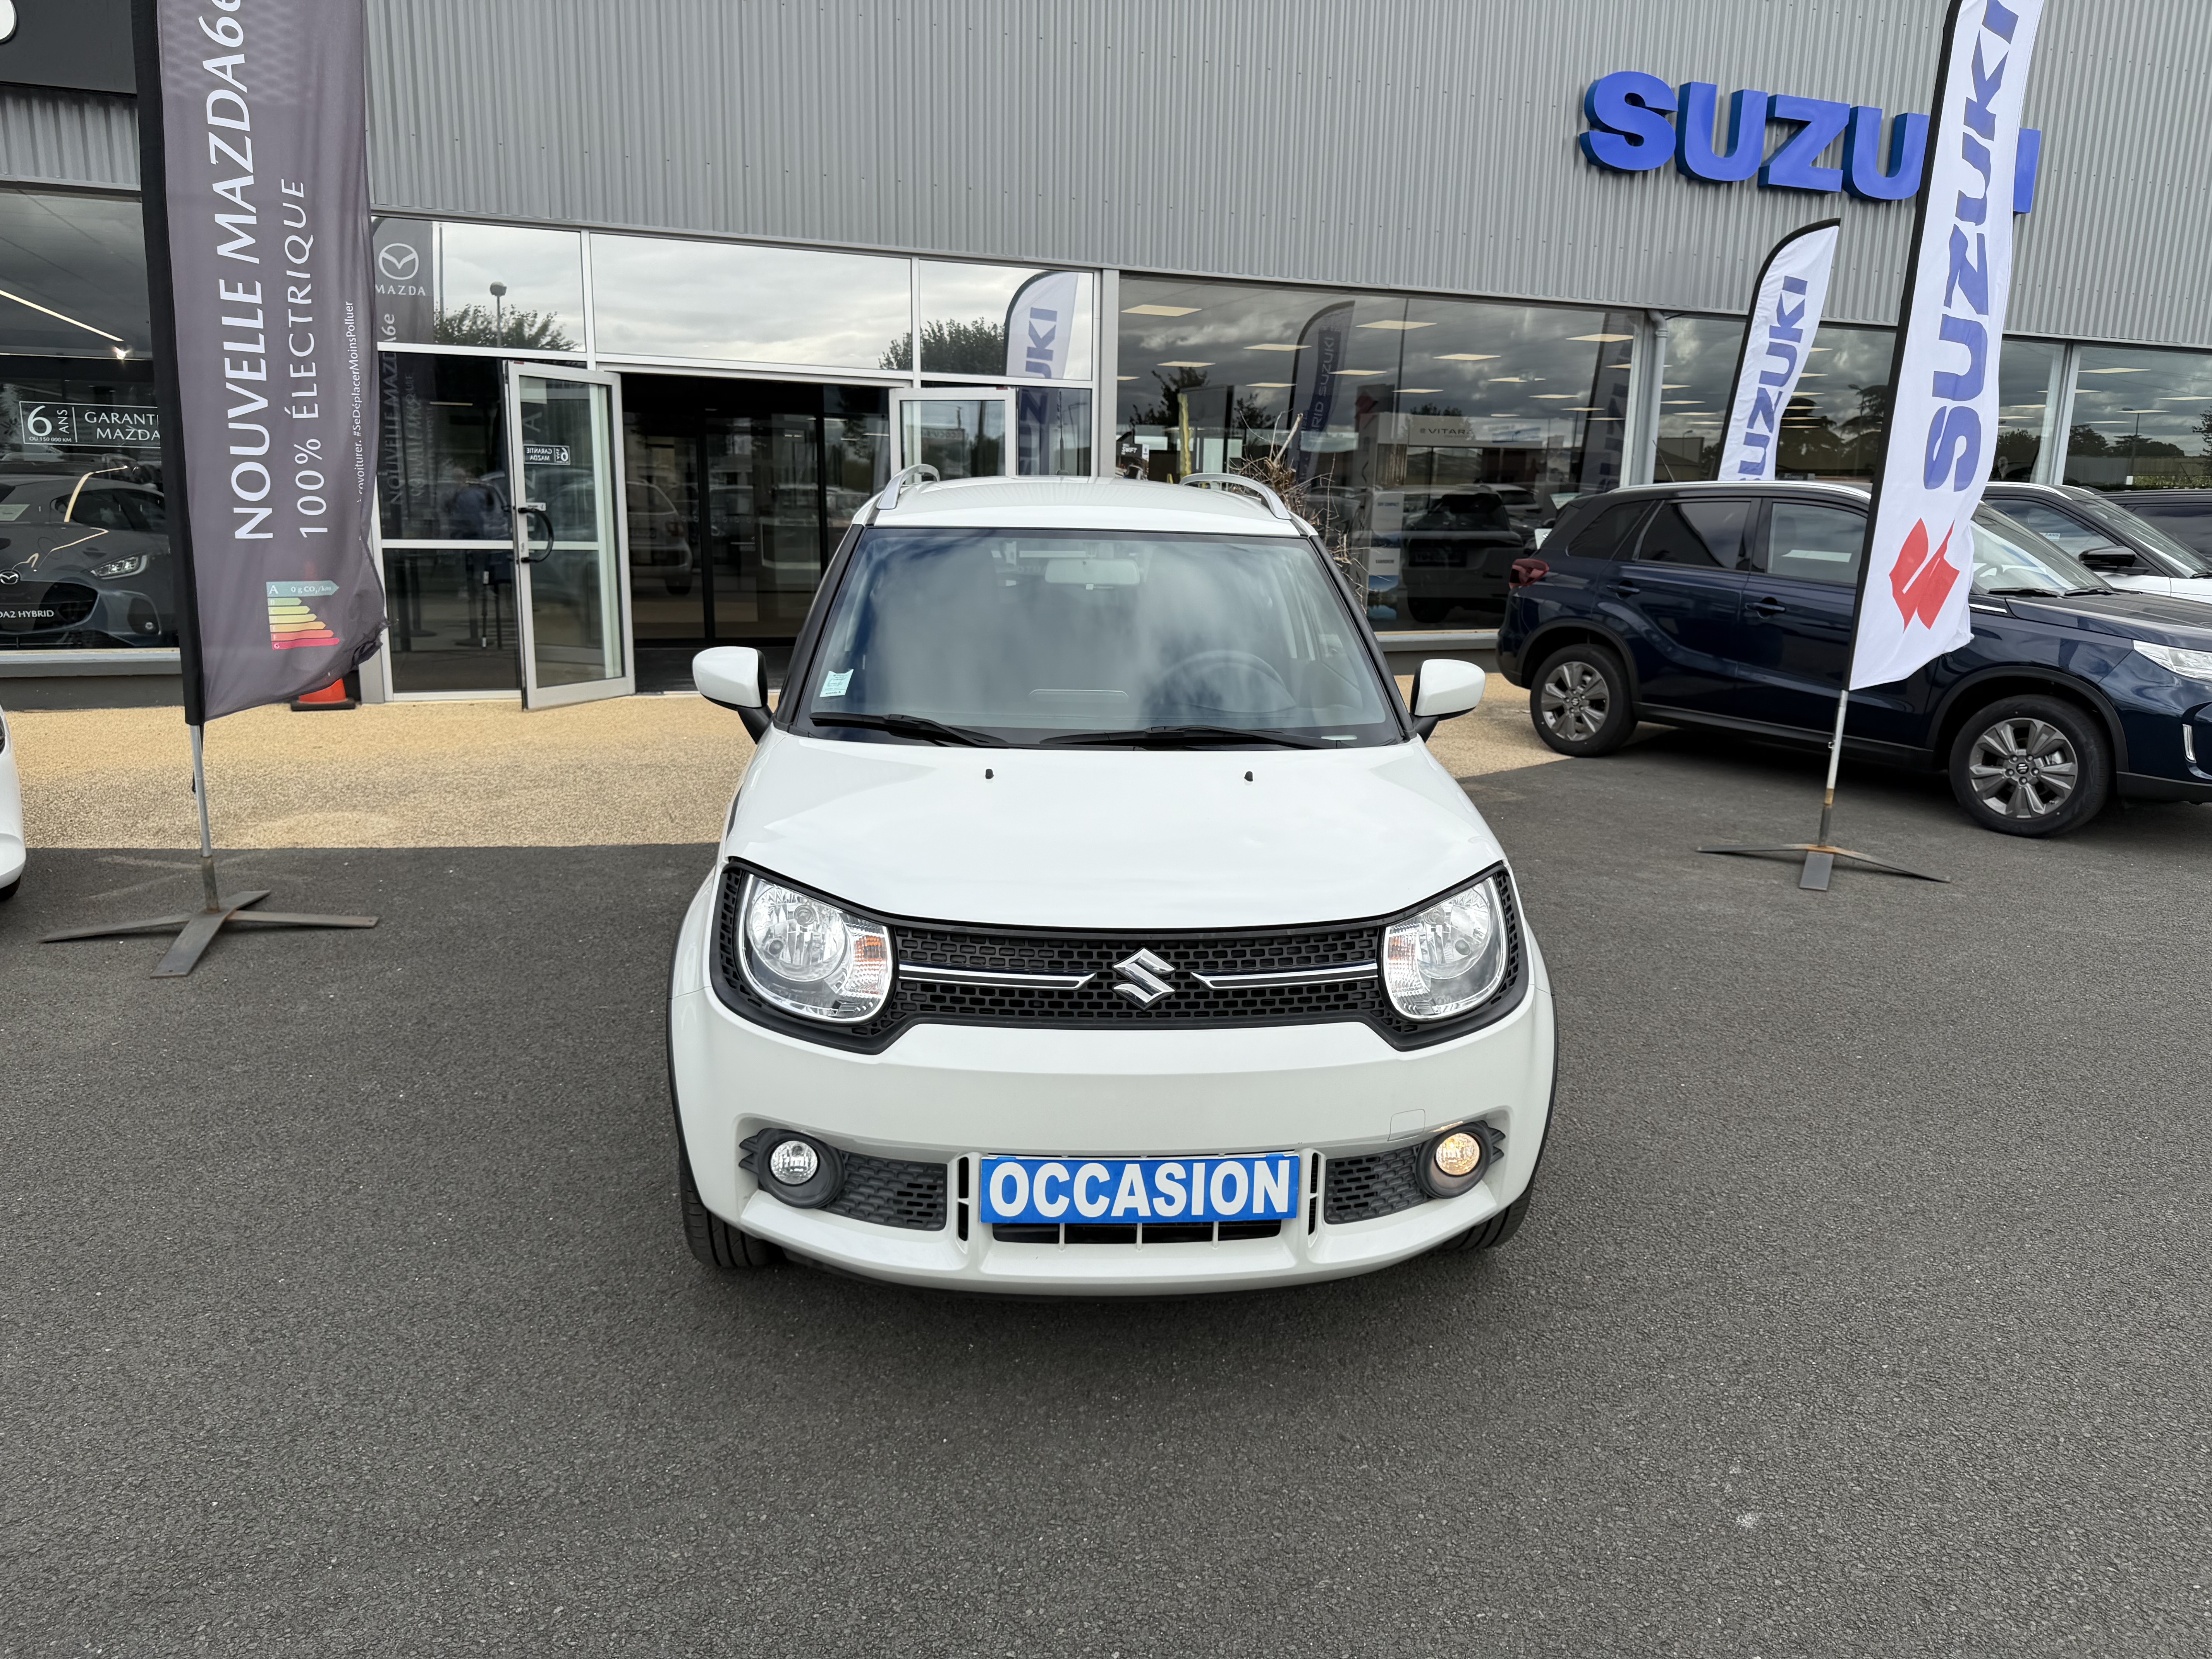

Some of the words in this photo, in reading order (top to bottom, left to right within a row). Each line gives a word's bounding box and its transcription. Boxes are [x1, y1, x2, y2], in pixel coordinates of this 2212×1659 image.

[1579, 70, 2041, 213] SUZUI
[1923, 0, 2019, 492] SUZUKI
[281, 178, 319, 419] ÉLECTRIQUE
[375, 284, 426, 296] MAZDA
[344, 301, 362, 436] #SeDéplacerMoinsPolluer
[1738, 275, 1808, 479] UZUKI
[27, 405, 52, 436] 6
[57, 409, 70, 434] ANS
[84, 412, 159, 426] GARANTI
[96, 428, 160, 441] MAZDA
[219, 279, 273, 539] NOUVELLE
[294, 438, 328, 539] 100%
[18, 610, 55, 618] HYBRID
[269, 585, 279, 594] A
[989, 1159, 1290, 1218] OCCASION
